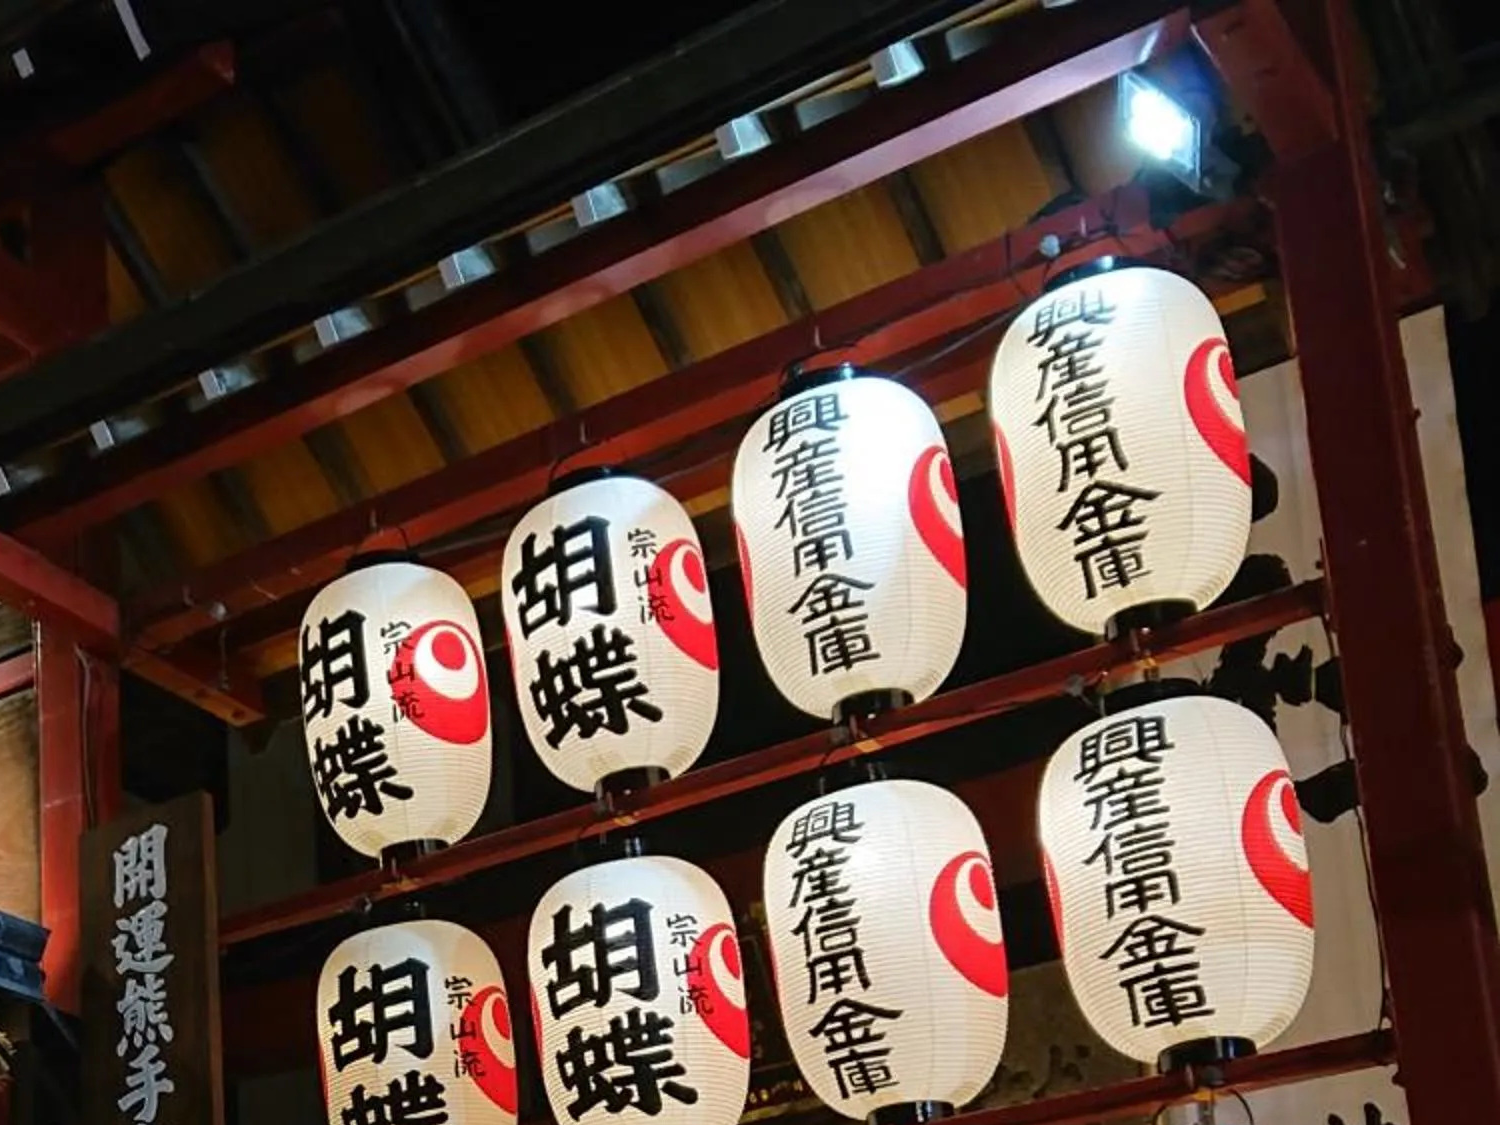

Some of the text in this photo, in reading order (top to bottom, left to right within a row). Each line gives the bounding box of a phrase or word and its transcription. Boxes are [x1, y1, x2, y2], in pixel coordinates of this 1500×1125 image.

[763, 391, 882, 677] 興産信用金庫
[1026, 289, 1166, 600] 興産信用金庫
[380, 621, 426, 724] 宗山流
[512, 515, 663, 750] 胡蝶
[627, 527, 675, 625] 宗山流
[300, 609, 414, 823] 胡蝶
[666, 912, 714, 1017] 宗山流
[786, 801, 904, 1100] 興産信用金庫
[1074, 715, 1216, 1029] 興産信用金庫
[444, 975, 487, 1080] 宗山流
[542, 898, 698, 1122] 胡蝶
